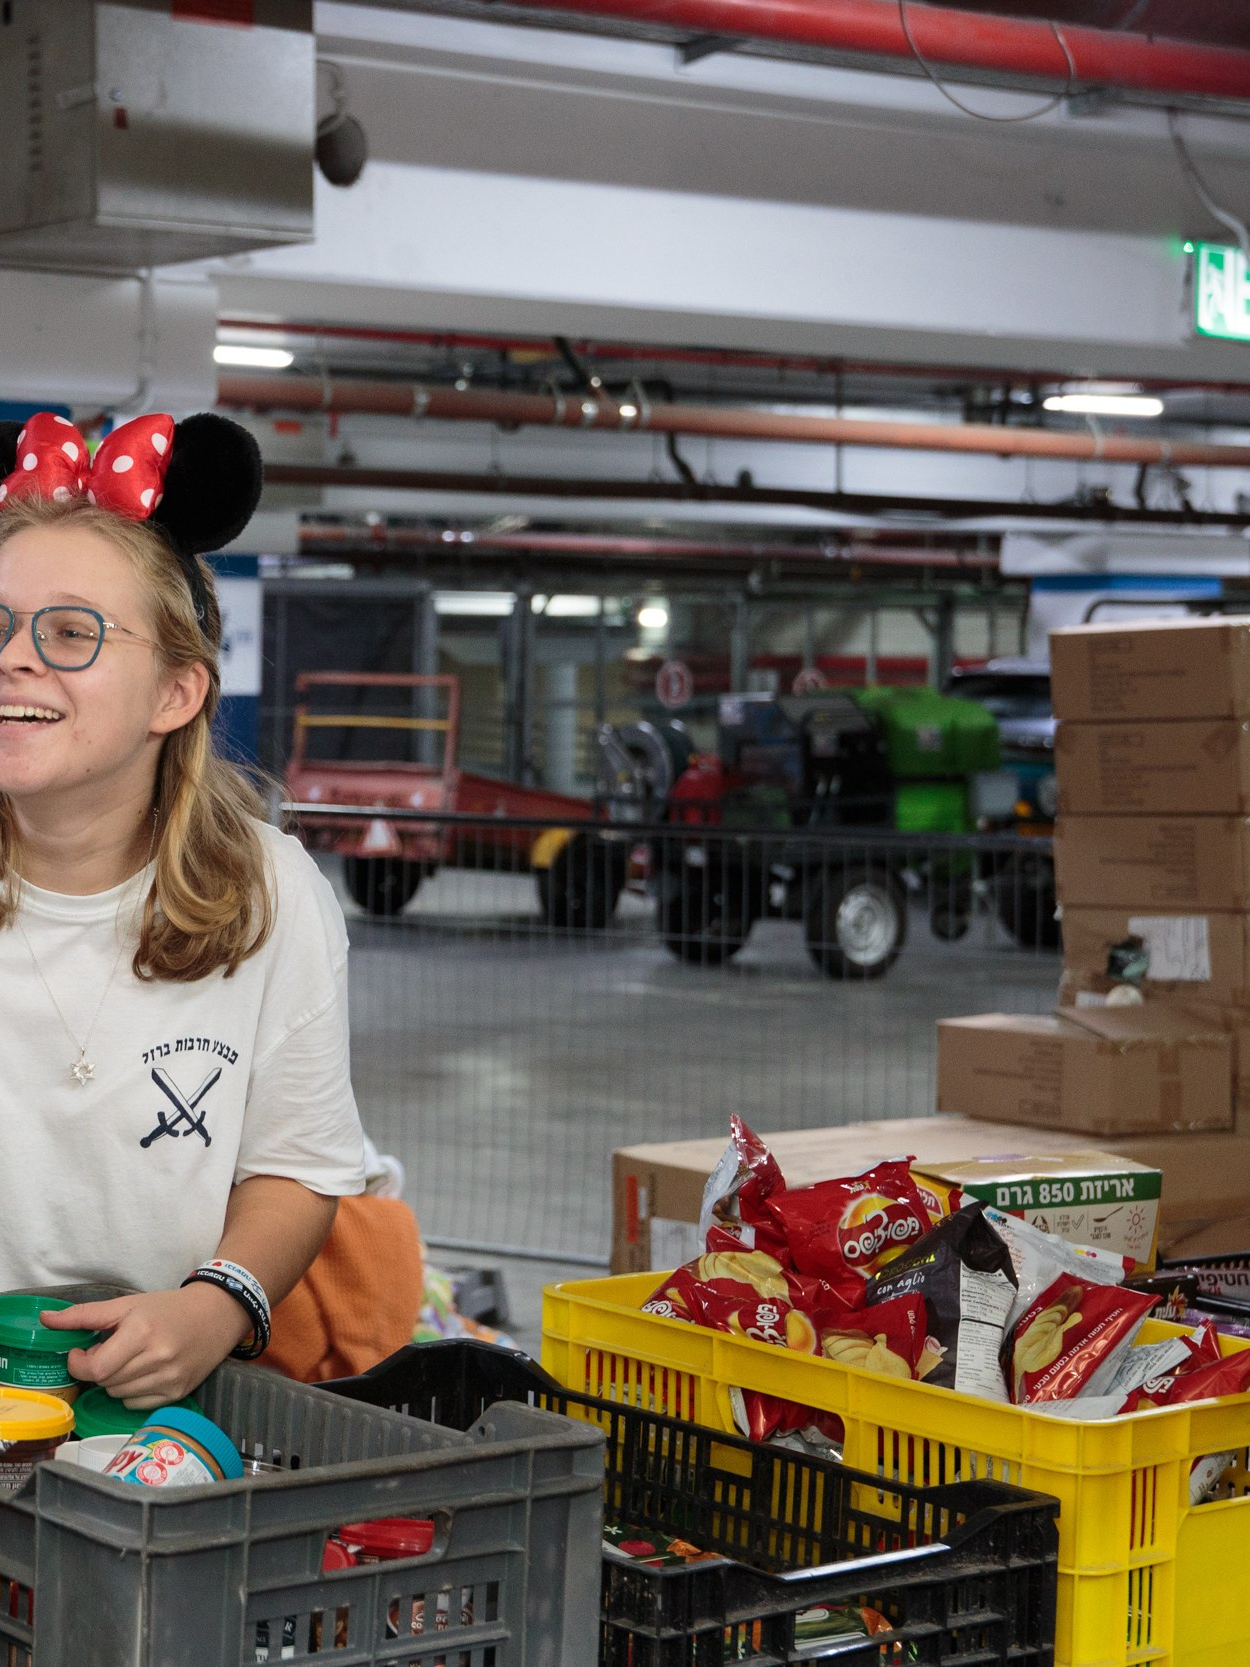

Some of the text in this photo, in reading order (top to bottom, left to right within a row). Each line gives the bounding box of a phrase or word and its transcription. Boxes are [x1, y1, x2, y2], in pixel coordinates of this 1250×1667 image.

[141, 1037, 239, 1065] מבצע חרבות ברזל
[996, 1177, 1135, 1207] אריזת 850 גרם
[1033, 1307, 1123, 1390] חטיף תפוח אדמה בטעם טבעי
